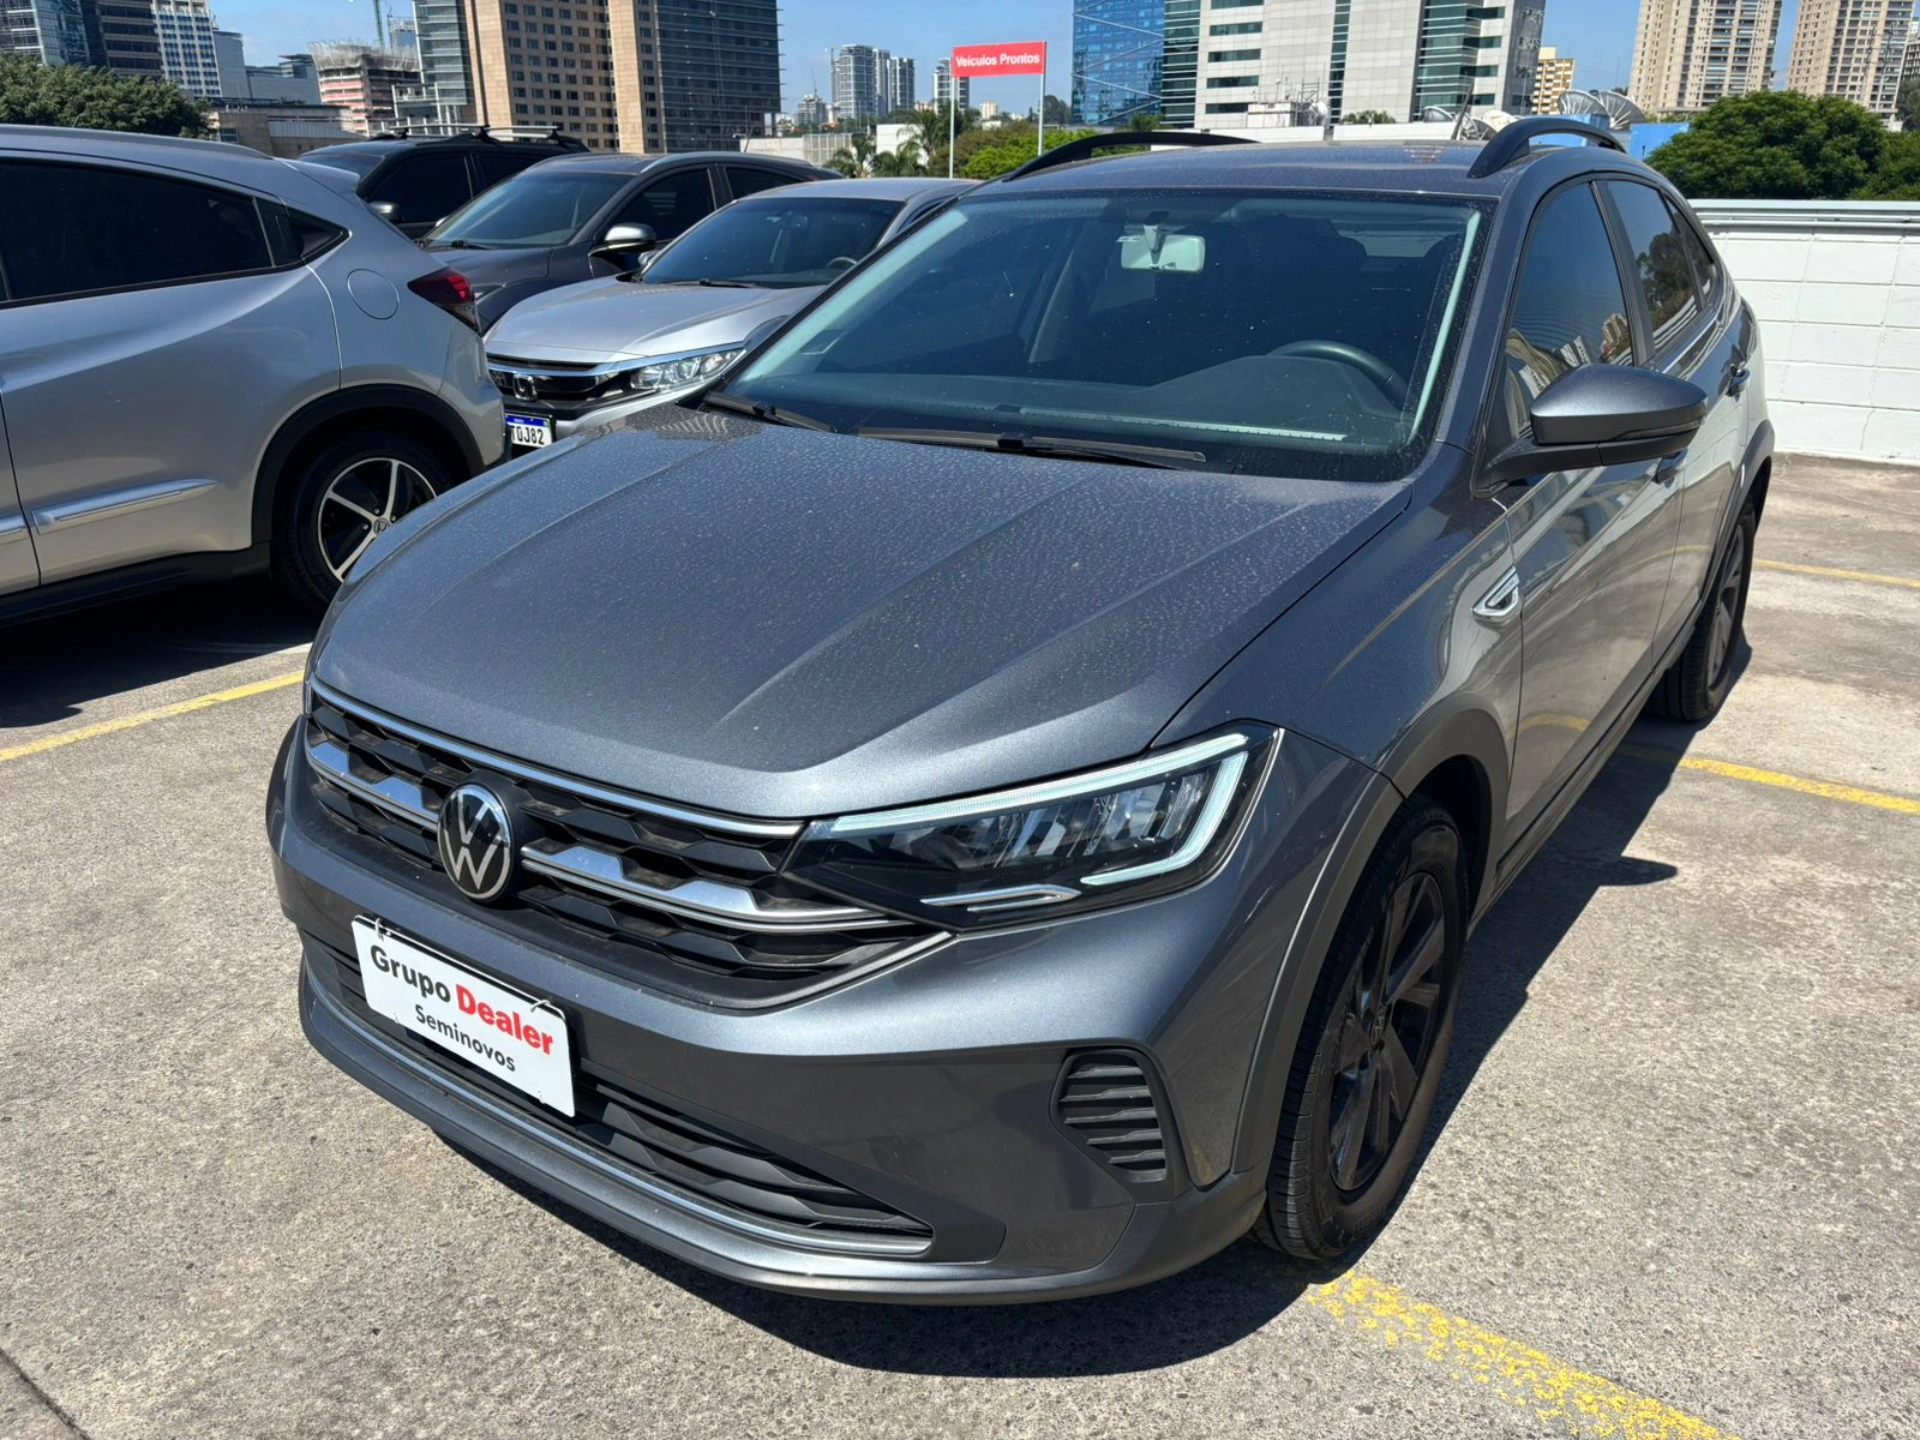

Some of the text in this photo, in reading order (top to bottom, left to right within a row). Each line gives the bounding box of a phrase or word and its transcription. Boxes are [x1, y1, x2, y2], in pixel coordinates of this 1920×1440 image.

[1000, 53, 1040, 65] Prontos
[370, 945, 554, 1056] Grupo Dealer
[415, 1004, 516, 1072] Seminovos
